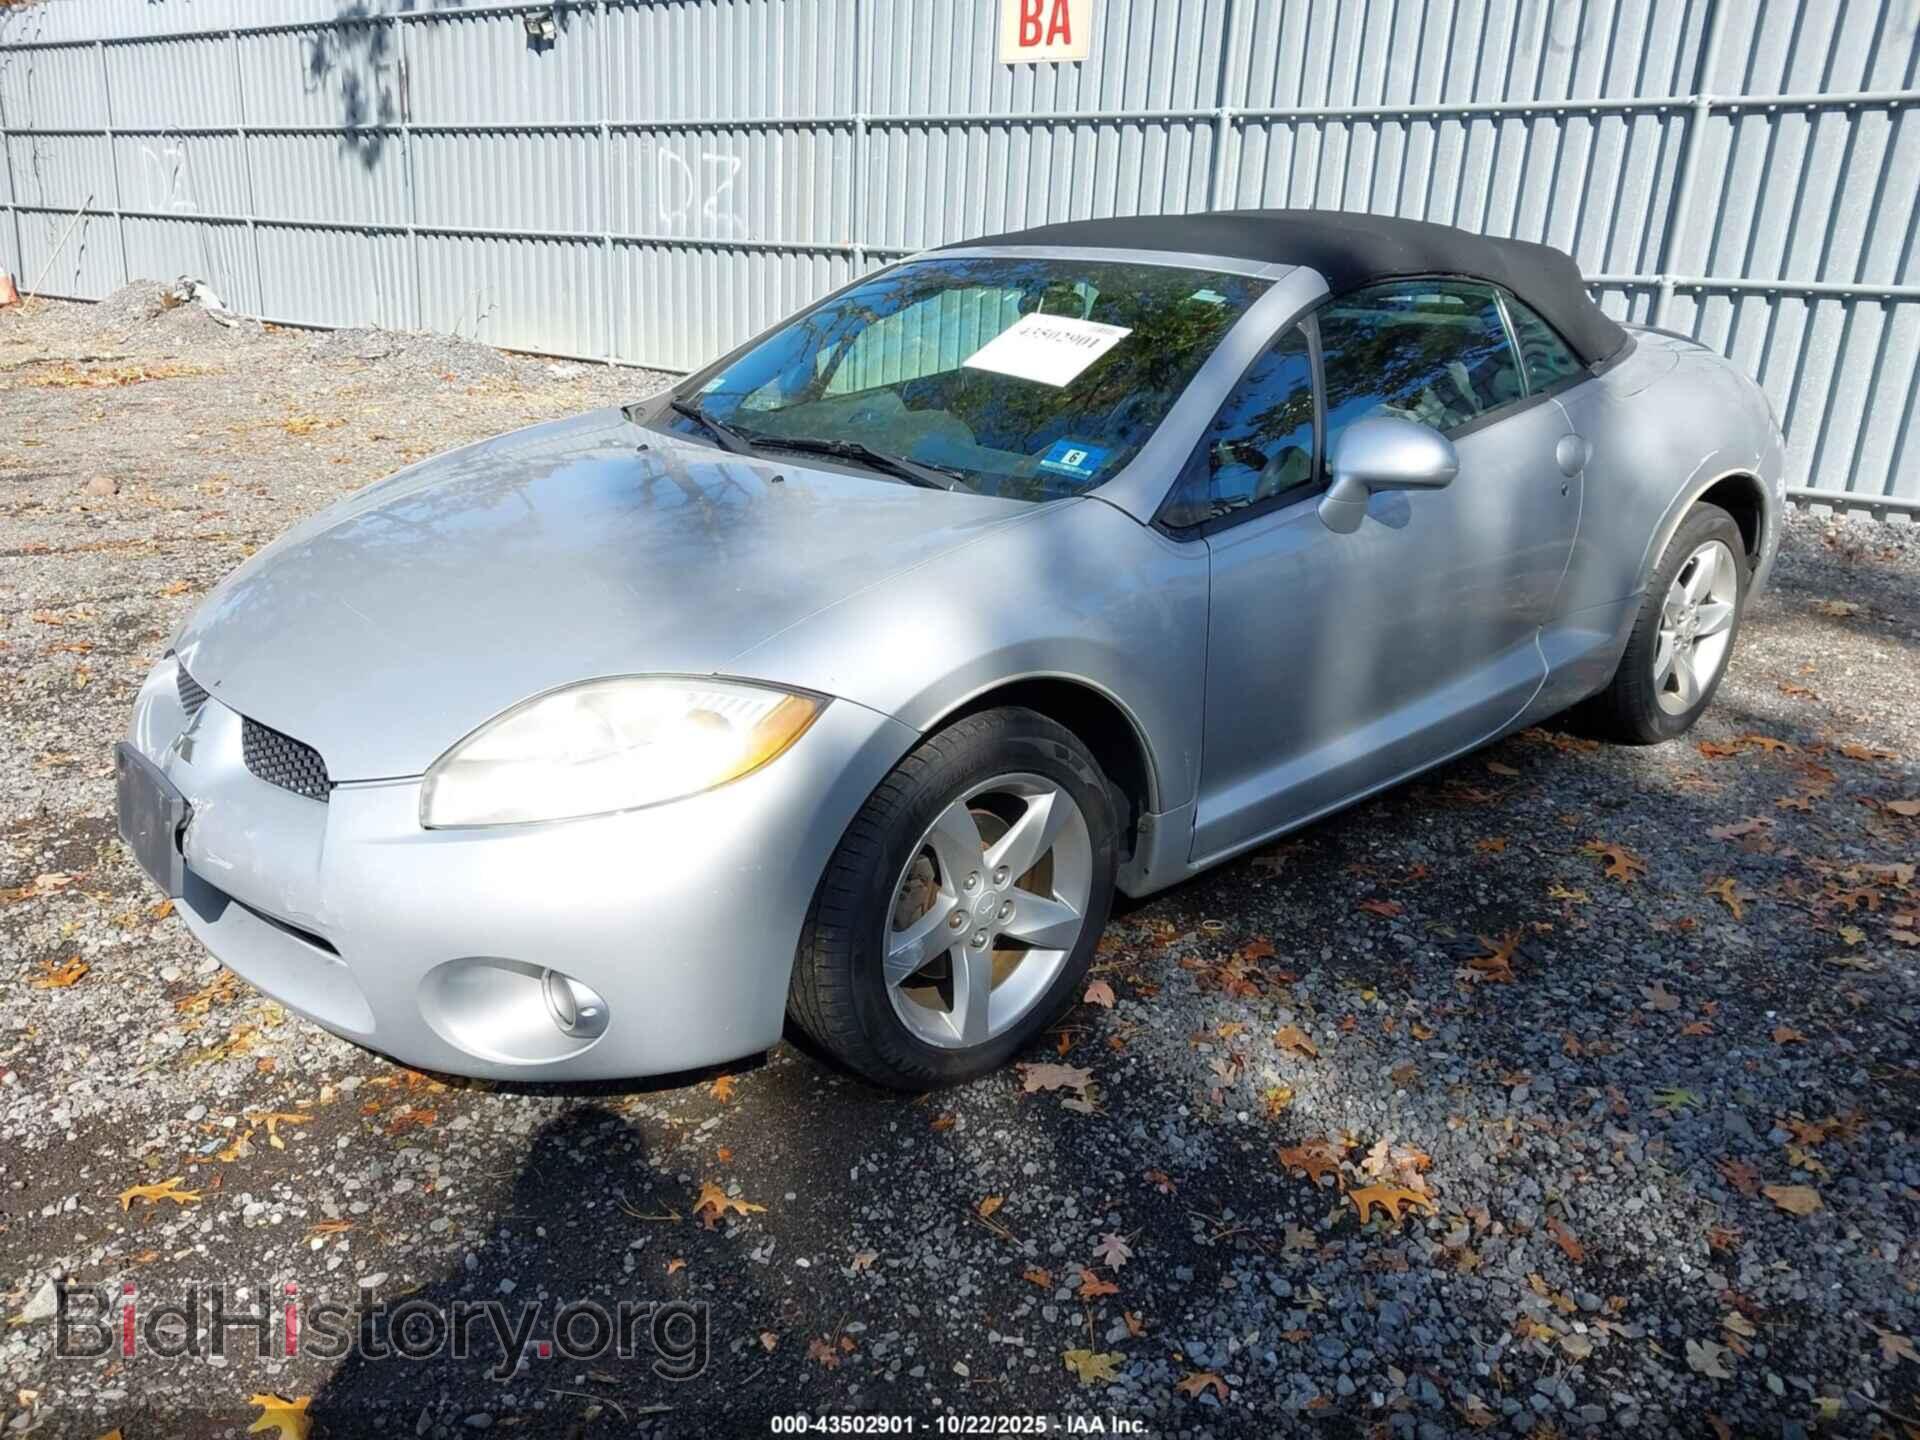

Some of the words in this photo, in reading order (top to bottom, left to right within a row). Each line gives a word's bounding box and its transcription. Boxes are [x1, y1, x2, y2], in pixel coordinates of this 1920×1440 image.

[1019, 0, 1071, 47] BA
[659, 147, 747, 232] DZ
[1068, 452, 1081, 463] 6
